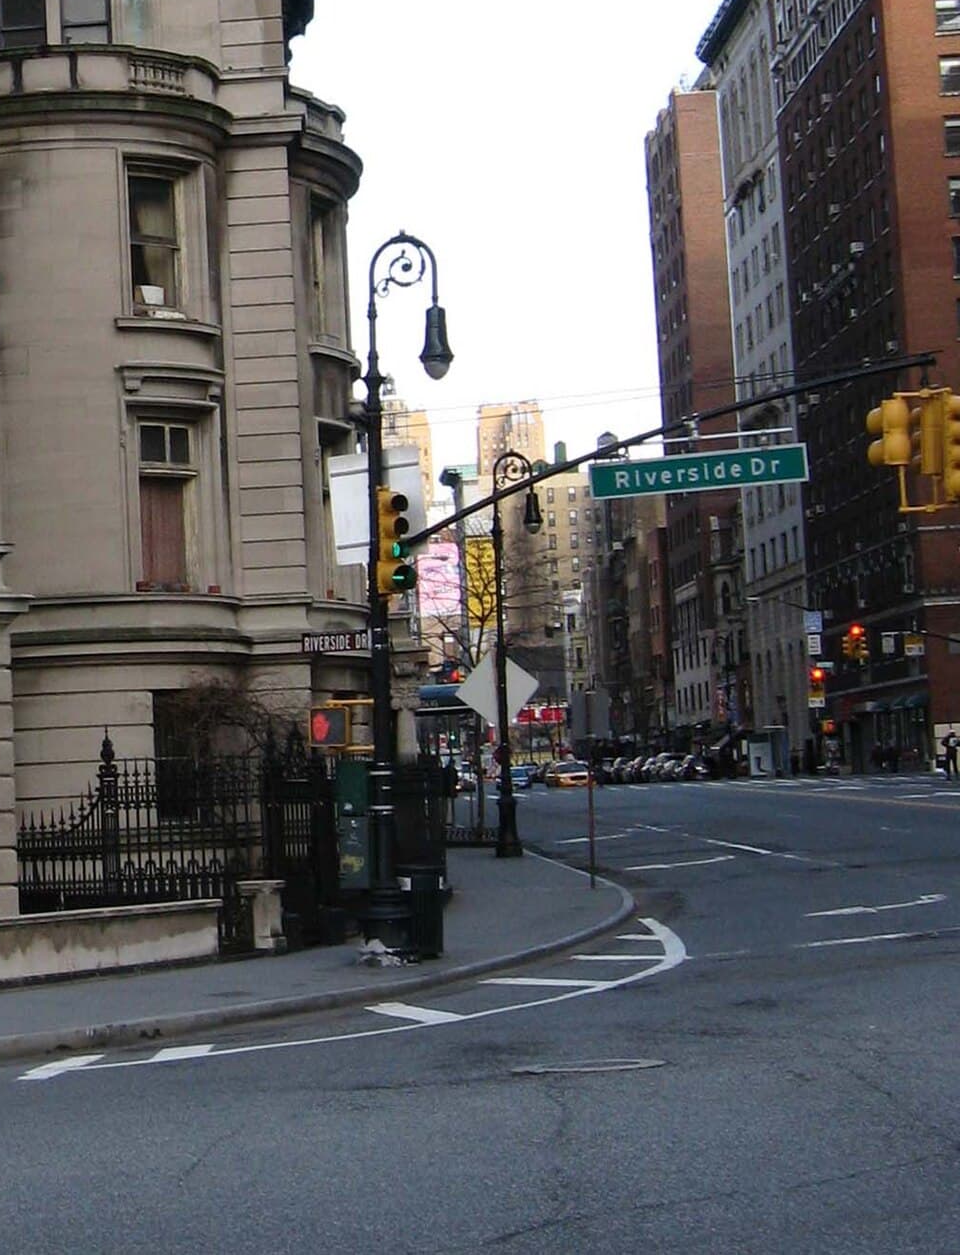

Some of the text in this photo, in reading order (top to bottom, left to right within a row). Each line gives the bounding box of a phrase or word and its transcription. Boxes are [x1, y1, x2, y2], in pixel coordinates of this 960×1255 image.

[615, 458, 780, 489] Riverside Dr
[303, 633, 368, 652] RIVERSIDE DR
